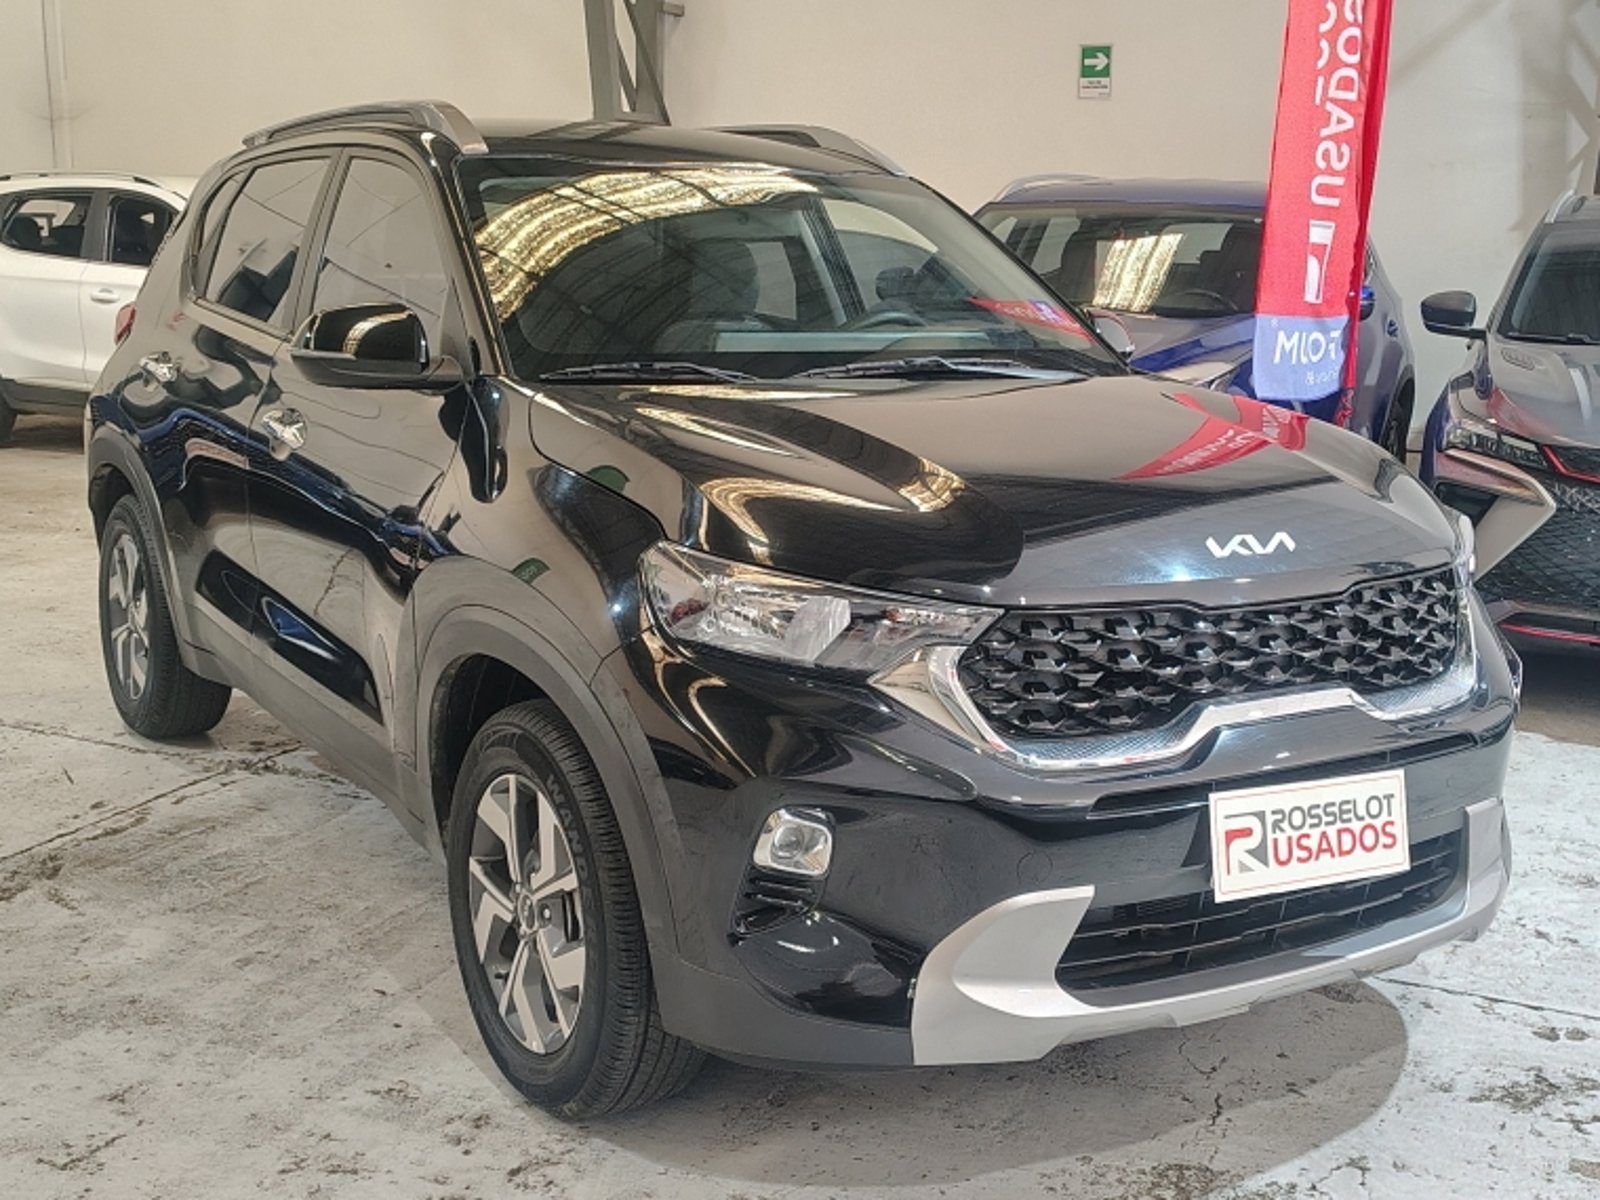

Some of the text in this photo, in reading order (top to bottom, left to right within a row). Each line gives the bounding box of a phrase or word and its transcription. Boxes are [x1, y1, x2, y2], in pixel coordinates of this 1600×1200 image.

[1204, 531, 1297, 559] KIA
[1270, 793, 1395, 835] ROSSELOT
[1272, 820, 1398, 867] USADOS
